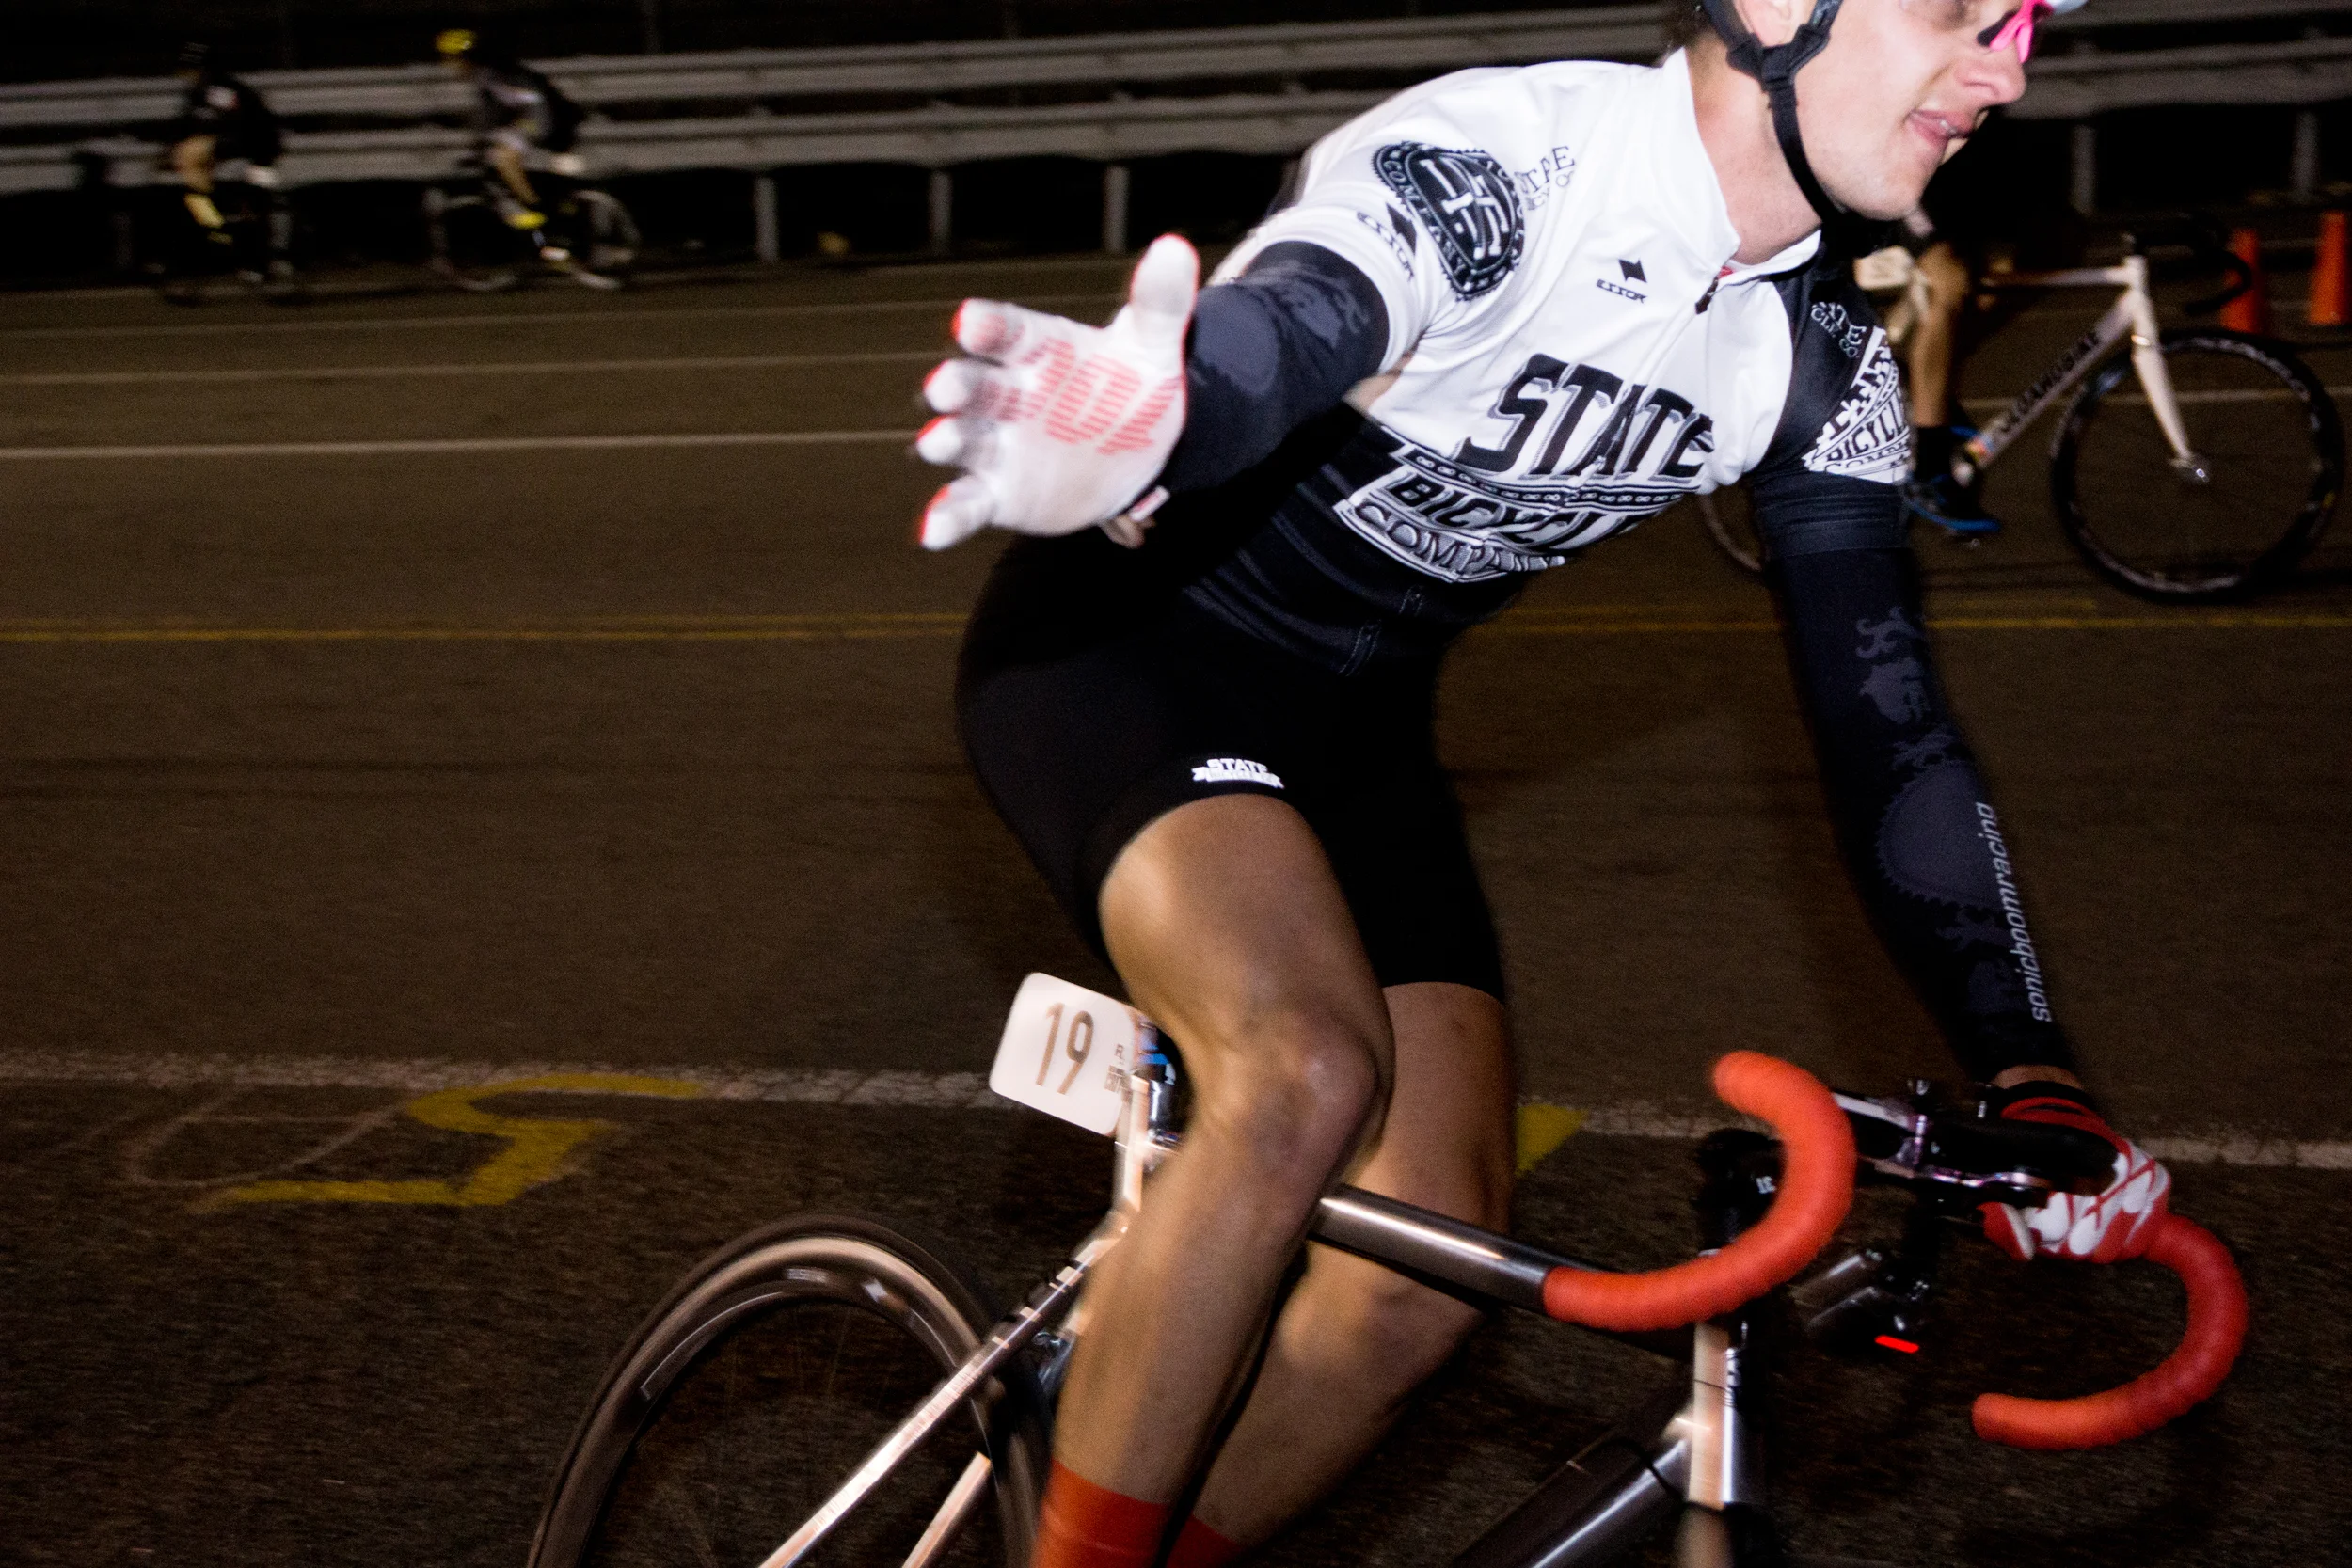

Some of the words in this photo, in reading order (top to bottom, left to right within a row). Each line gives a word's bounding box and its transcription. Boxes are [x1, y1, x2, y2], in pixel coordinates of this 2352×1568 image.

[1451, 353, 1714, 484] STATE
[1826, 389, 1908, 461] BICYCL
[1206, 758, 1268, 773] STATE
[1976, 801, 2052, 1022] sonicboomracing
[1036, 1002, 1094, 1096] 19
